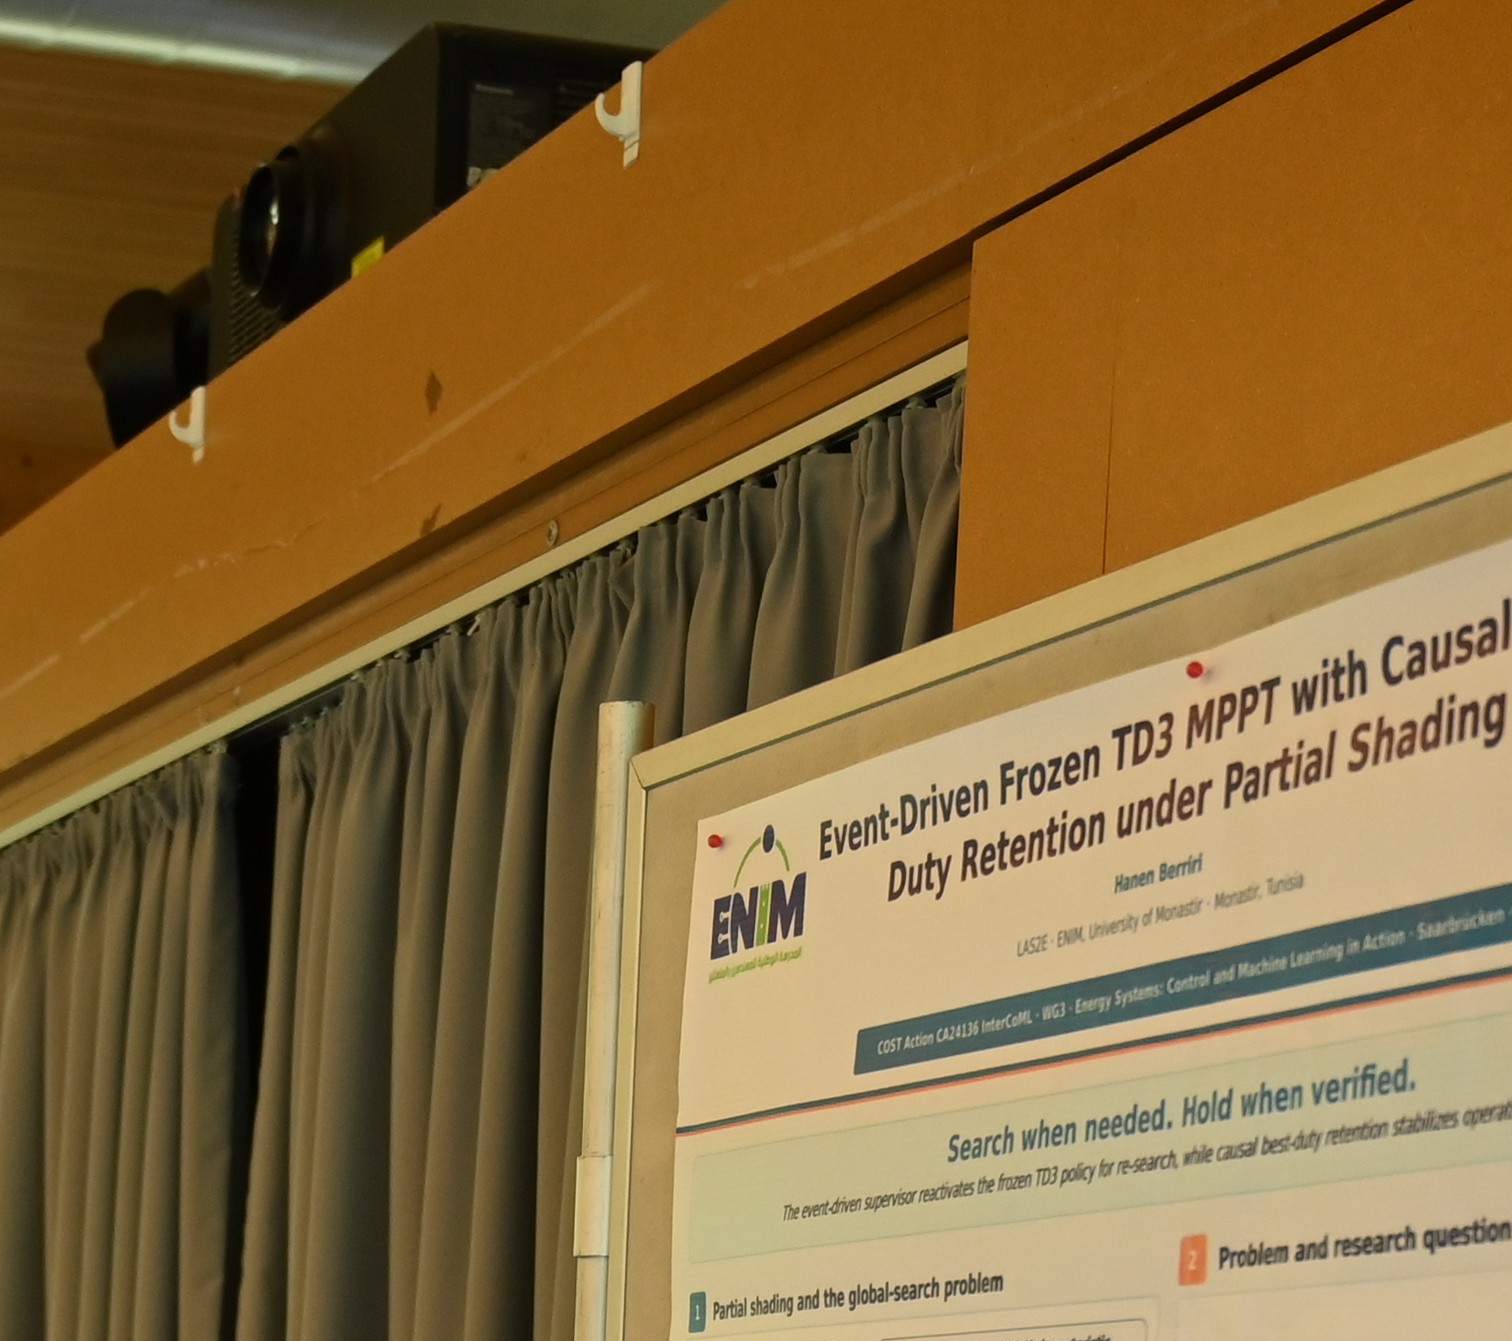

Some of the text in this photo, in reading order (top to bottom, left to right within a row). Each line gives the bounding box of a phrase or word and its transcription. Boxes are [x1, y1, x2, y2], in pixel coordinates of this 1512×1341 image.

[819, 780, 989, 860] Event-Driven
[999, 745, 1101, 805] Frozen
[1111, 711, 1175, 771] TD3
[1185, 676, 1281, 749] MPPT
[1291, 649, 1368, 715] with
[1380, 598, 1512, 686] Causal
[887, 693, 1507, 902] Duty Retention under Partial Shading
[710, 870, 808, 961] ENIM
[1113, 852, 1204, 894] Hanen Berriri
[876, 1035, 903, 1056] COST
[903, 1032, 935, 1050] Action
[1041, 1000, 1067, 1022] WG3
[1074, 995, 1113, 1015] Energy
[1165, 969, 1212, 995] Control
[1212, 964, 1237, 986] and
[1236, 956, 1289, 979] Machine
[1289, 943, 1345, 969] Learning
[1345, 938, 1361, 955] in
[1361, 930, 1406, 952] Action
[947, 1058, 1416, 1164] Search when needed. Hold when verified.
[782, 1203, 801, 1222] The
[800, 1196, 863, 1220] event-driven
[863, 1188, 918, 1213] supervisor
[917, 1180, 976, 1204] reactivates
[976, 1175, 996, 1196] the
[996, 1172, 1034, 1192] frozen
[1035, 1164, 1060, 1187] TD3
[1058, 1161, 1097, 1188] policy
[1097, 1157, 1116, 1179] for
[1115, 1149, 1179, 1176] re-search,
[1182, 1143, 1215, 1167] while
[1215, 1136, 1260, 1163] causal
[1260, 1129, 1323, 1156] best-duty
[1324, 1121, 1390, 1146] retention
[1392, 1109, 1460, 1137] stabilizes
[694, 1271, 1005, 1322] 1 Partial shading and the global-search problem
[1218, 1218, 1512, 1270] Problem and research question
